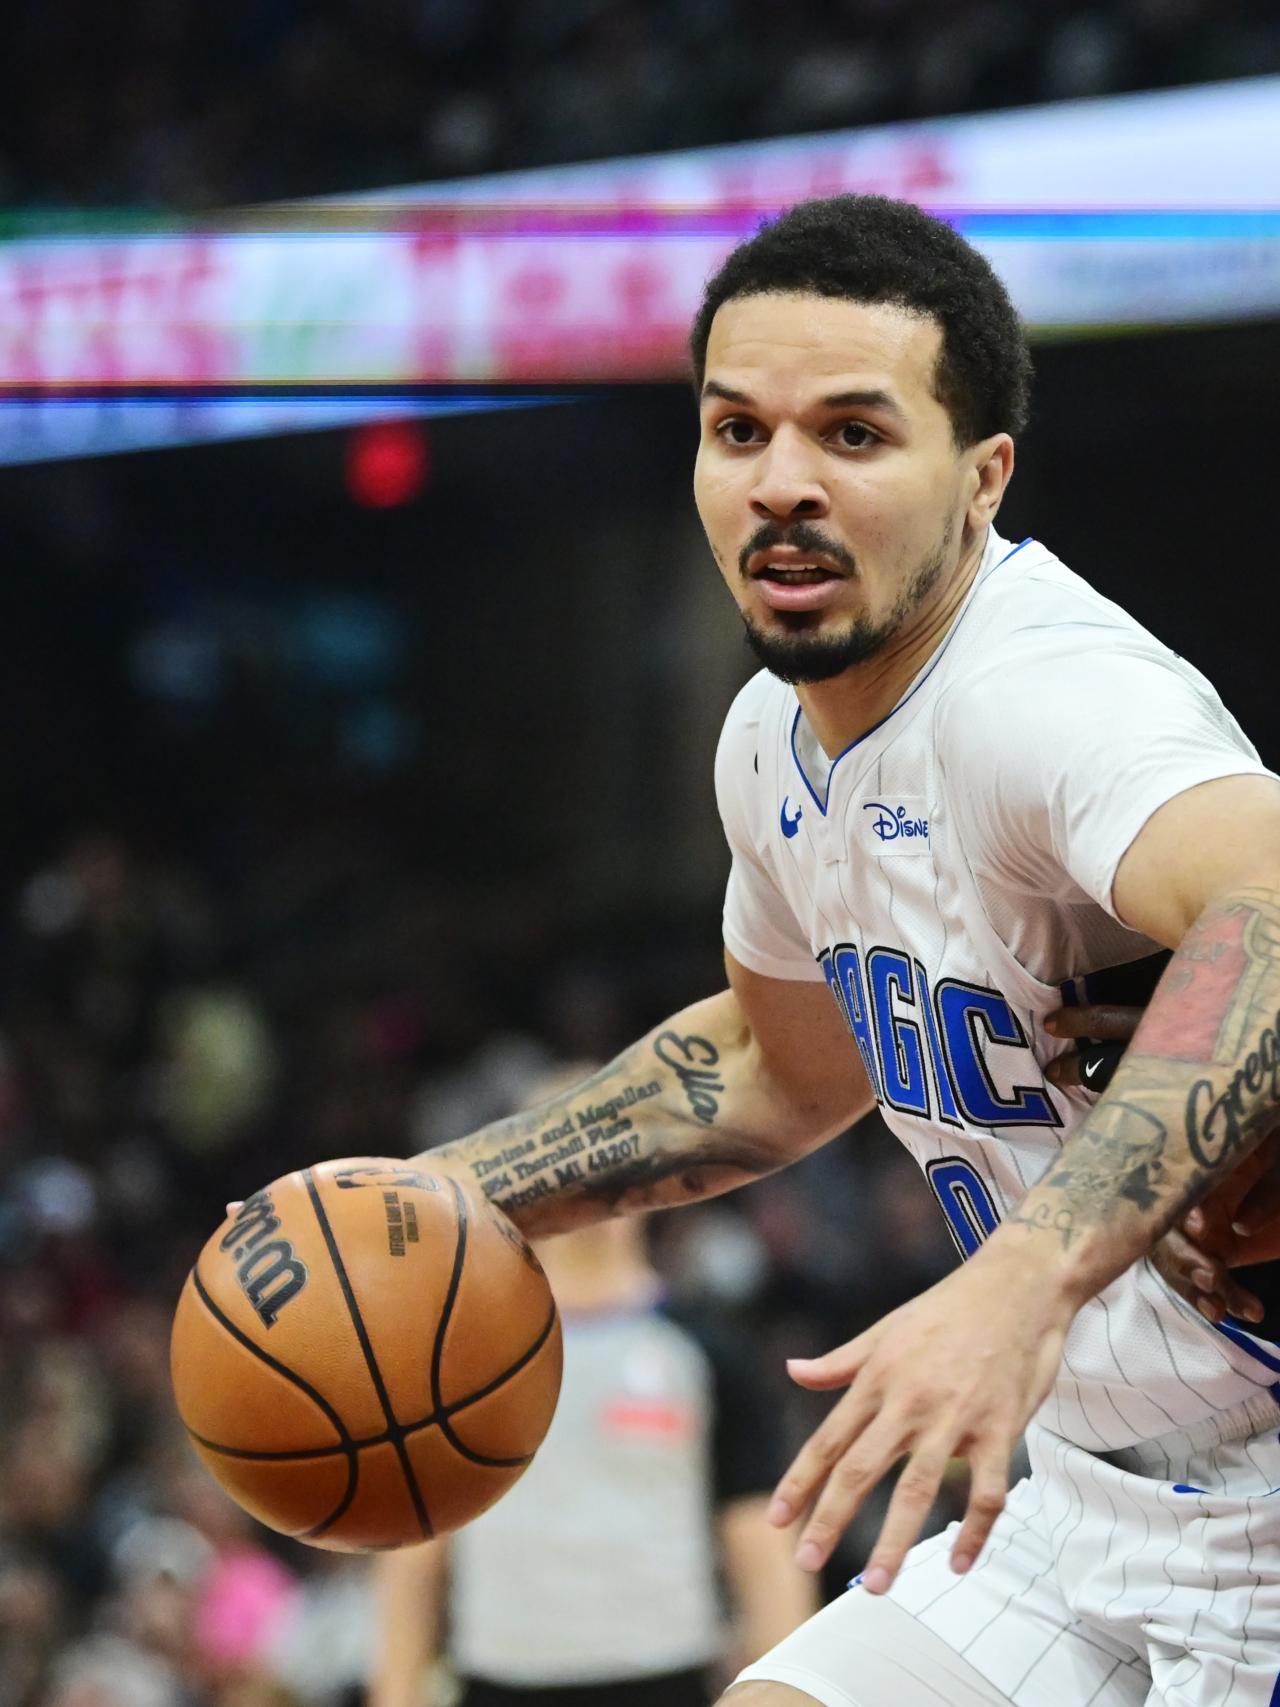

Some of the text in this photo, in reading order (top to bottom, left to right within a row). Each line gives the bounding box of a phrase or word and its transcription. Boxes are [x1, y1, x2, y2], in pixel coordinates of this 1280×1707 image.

[653, 1030, 726, 1124] Ella
[816, 943, 1064, 1129] AGIC
[541, 1117, 576, 1145] and
[576, 1080, 662, 1129] Magellan
[494, 1134, 641, 1211] etroit, MI 48207
